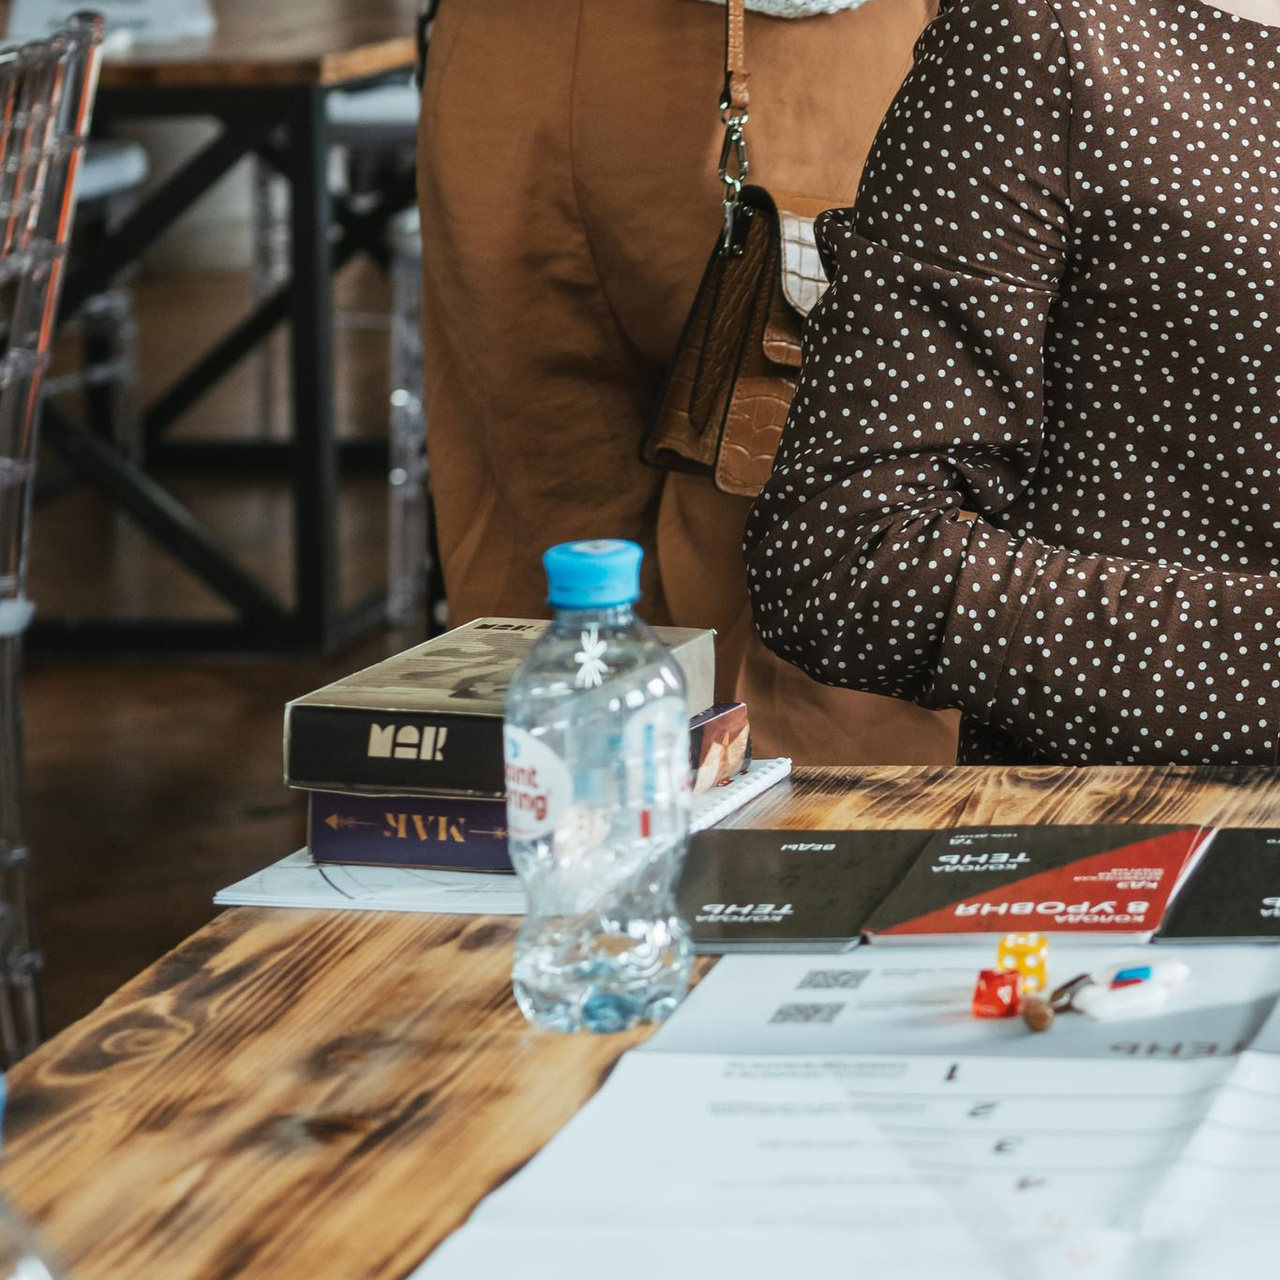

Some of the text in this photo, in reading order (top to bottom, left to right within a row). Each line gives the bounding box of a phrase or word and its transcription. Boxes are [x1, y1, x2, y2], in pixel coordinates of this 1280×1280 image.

[780, 843, 836, 851] ВЕДЫ
[938, 852, 1031, 864] ТЕНЬ
[931, 863, 1017, 873] КОЛОДА
[702, 904, 794, 914] ТЕНЬ
[954, 901, 1150, 917] 8 УРОВНЯ
[695, 915, 783, 923] КОЛОДА
[1054, 914, 1145, 924] КОЛОДА
